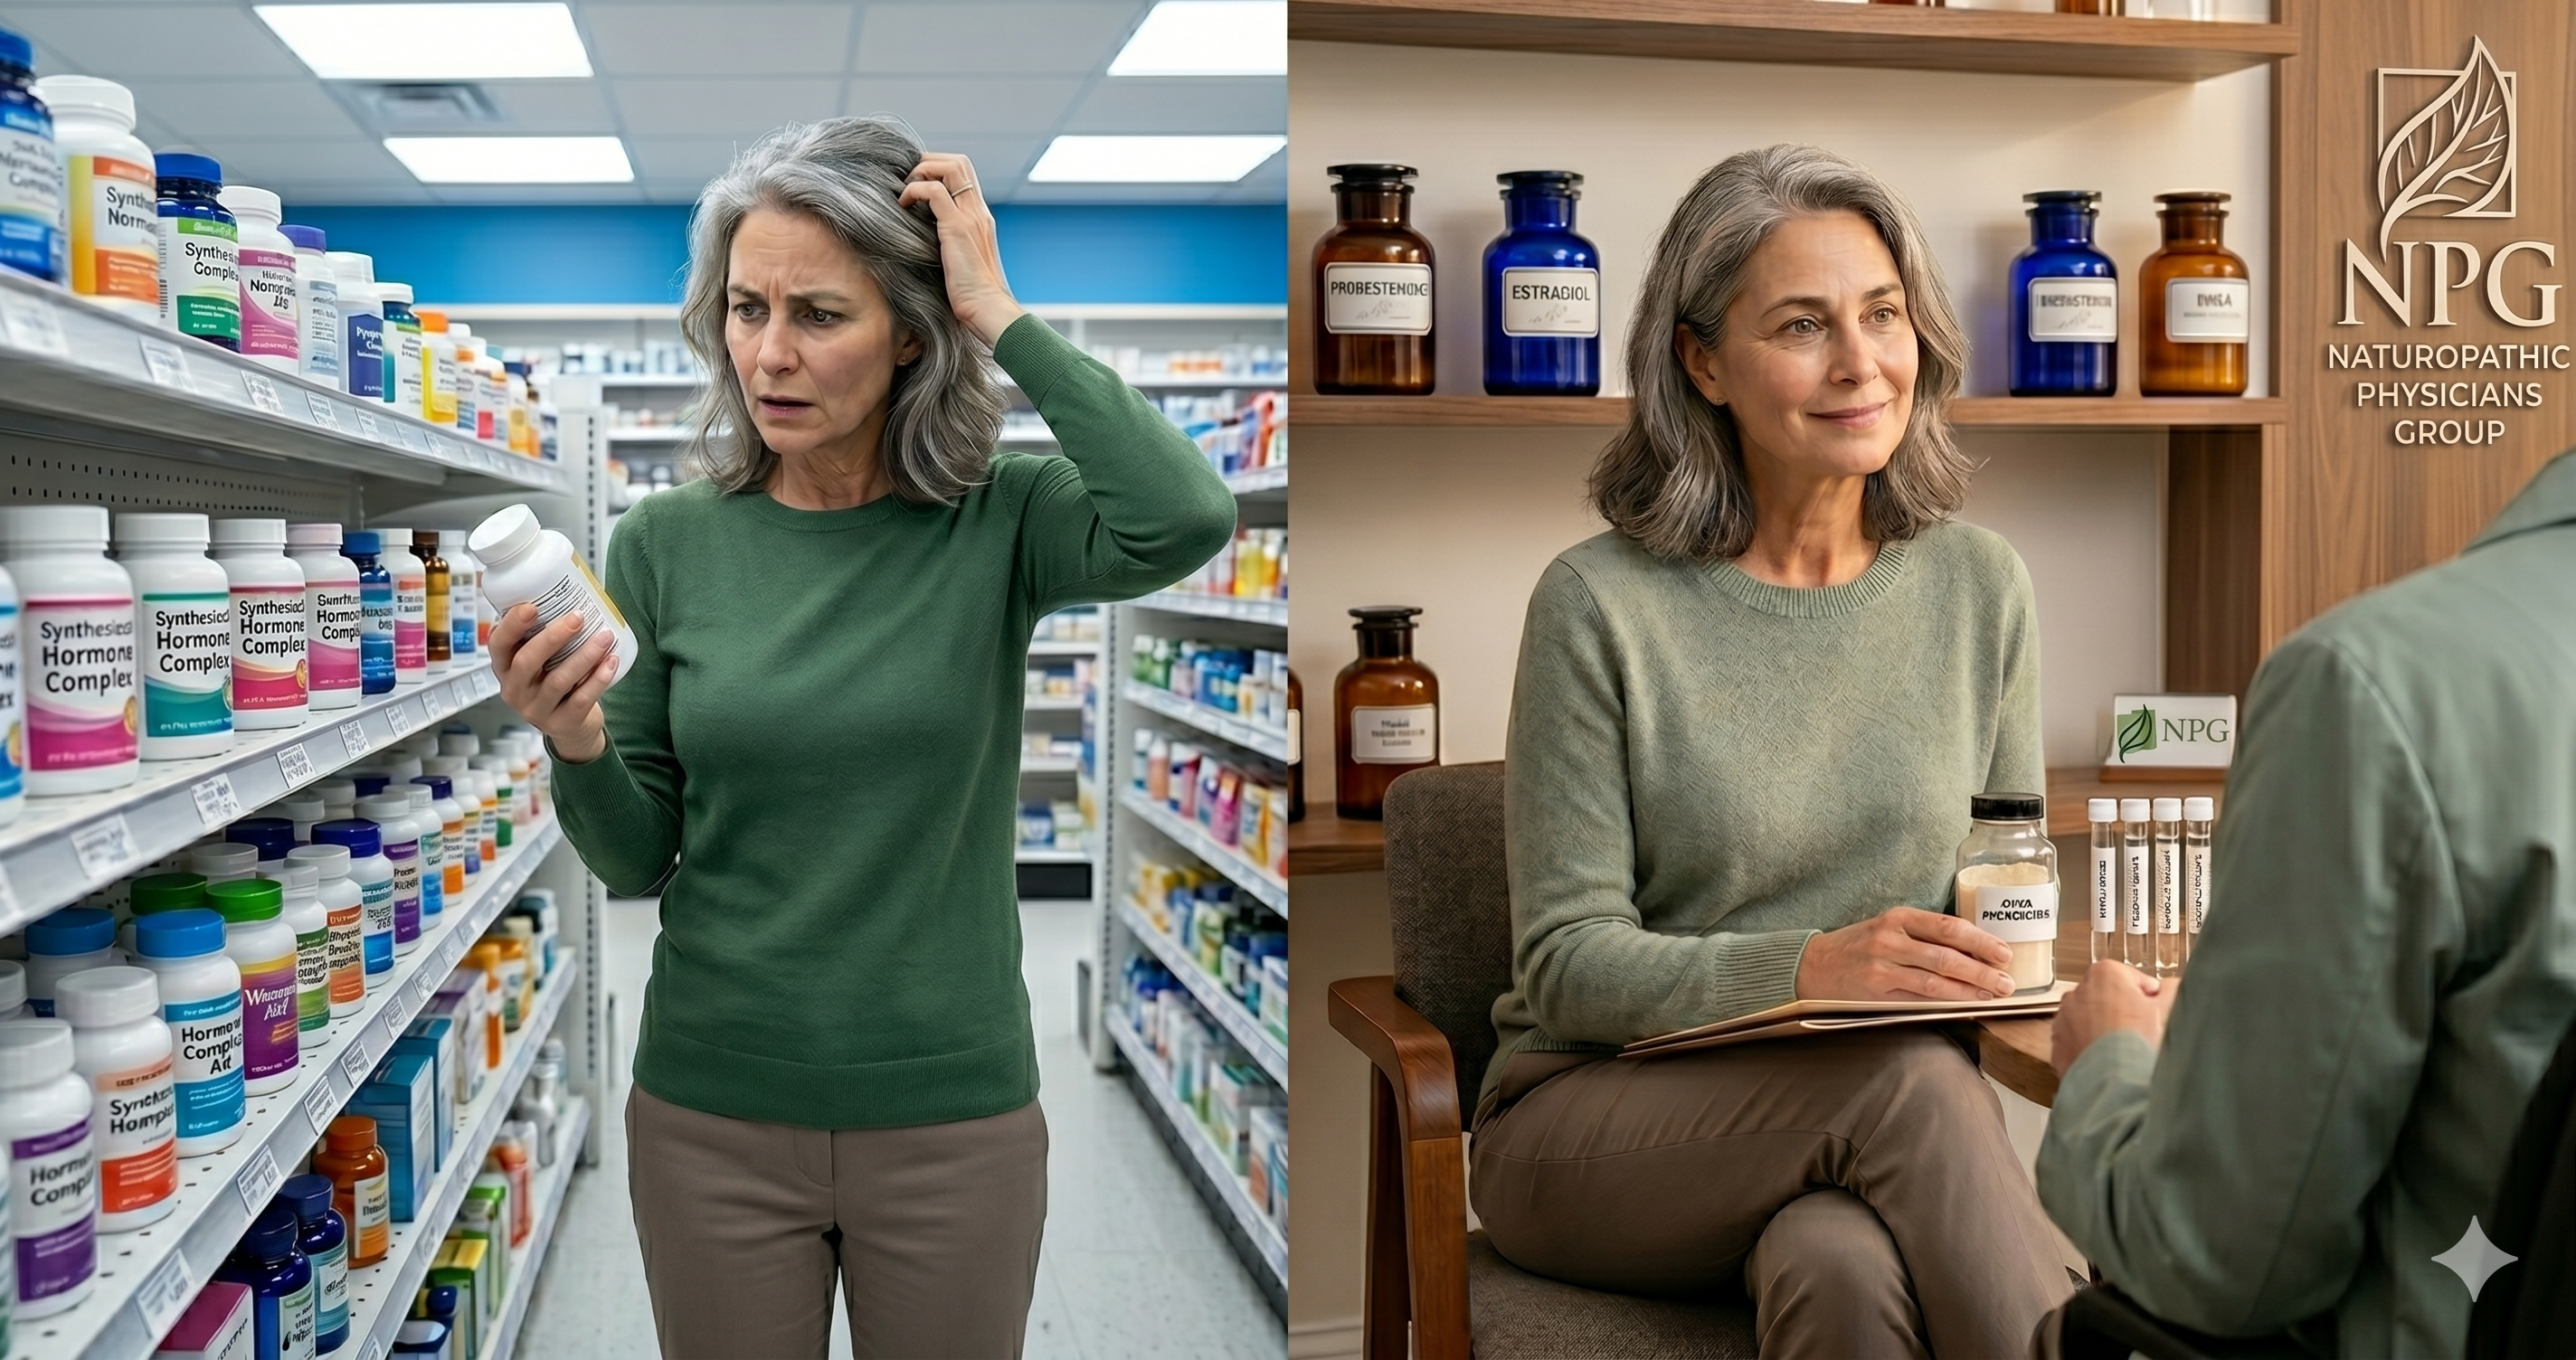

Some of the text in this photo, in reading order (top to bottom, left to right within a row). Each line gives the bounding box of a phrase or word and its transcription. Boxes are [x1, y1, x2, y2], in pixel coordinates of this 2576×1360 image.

[2336, 238, 2562, 327] NPG
[2328, 344, 2571, 370] NATUROPATHIC
[2357, 382, 2543, 408] PHYSICIANS
[2394, 420, 2505, 445] GROUP
[241, 619, 305, 635] Hormone
[156, 630, 230, 650] Hormone
[42, 645, 133, 667] Hormone
[159, 652, 230, 675] Complex
[45, 667, 133, 698] Complex
[2161, 718, 2230, 743] NPG
